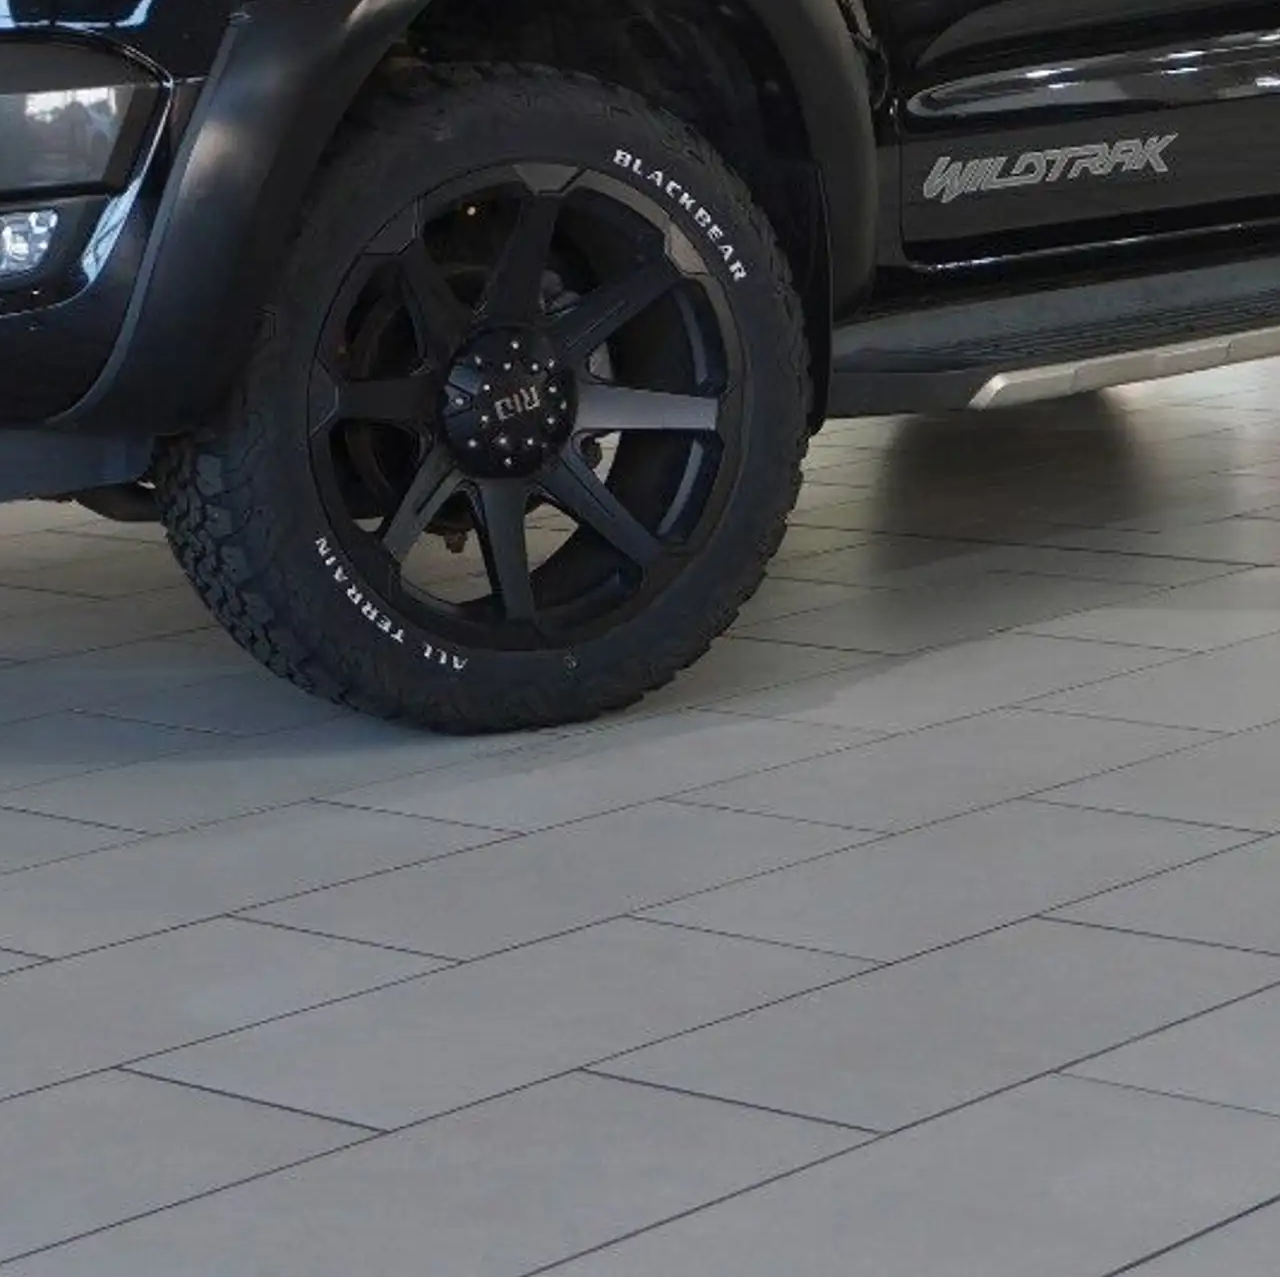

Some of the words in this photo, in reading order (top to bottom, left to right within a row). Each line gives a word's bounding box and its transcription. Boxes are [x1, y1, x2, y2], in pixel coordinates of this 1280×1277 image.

[922, 132, 1179, 204] WILDTRAK
[613, 149, 747, 281] BLACKBEAR
[315, 536, 405, 644] TERRAIN
[422, 643, 468, 670] ALL
